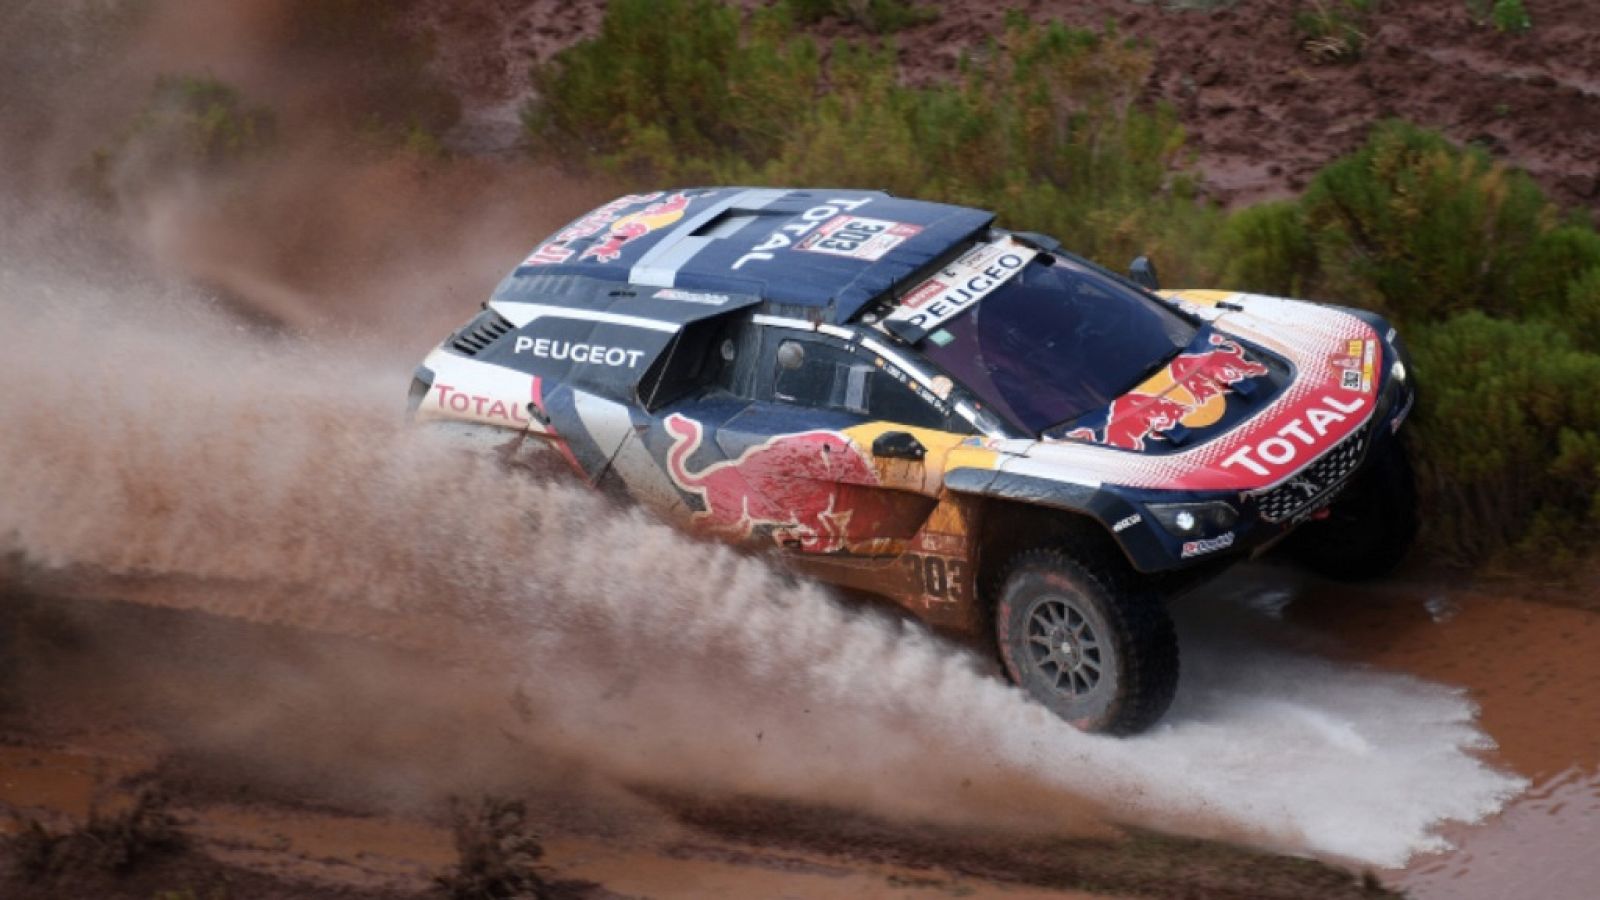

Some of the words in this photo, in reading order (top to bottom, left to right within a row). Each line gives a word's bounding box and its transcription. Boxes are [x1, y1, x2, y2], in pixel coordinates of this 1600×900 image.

[731, 198, 872, 270] TOTAL
[818, 221, 884, 252] 303
[514, 336, 644, 368] PEUGEOT
[436, 384, 528, 422] TOTAL
[1221, 396, 1364, 476] TOTAL
